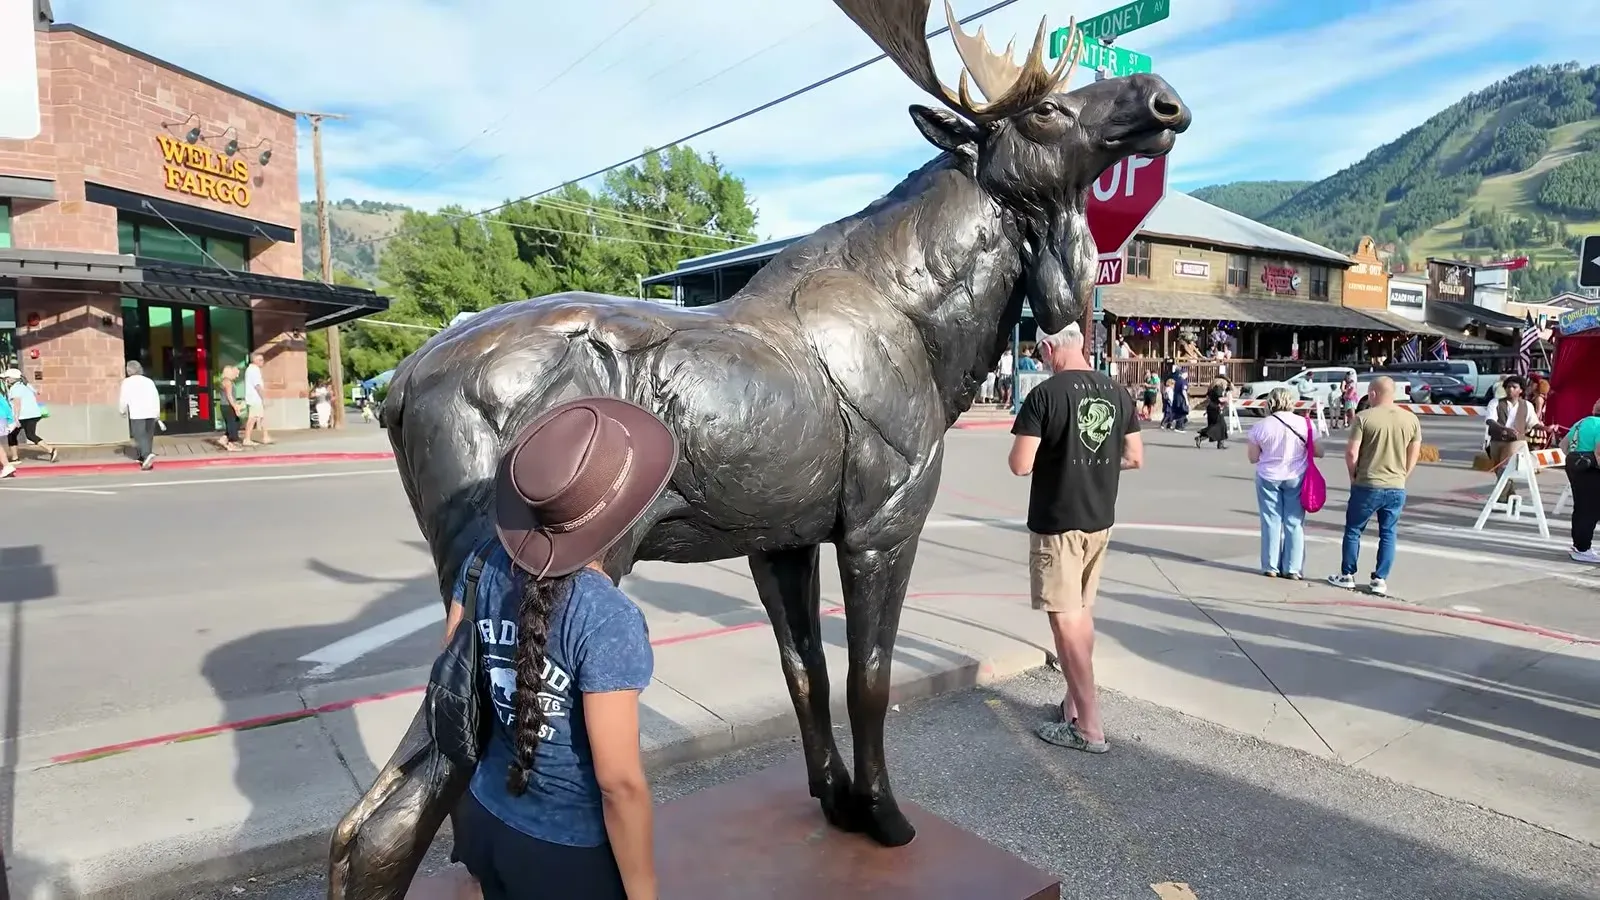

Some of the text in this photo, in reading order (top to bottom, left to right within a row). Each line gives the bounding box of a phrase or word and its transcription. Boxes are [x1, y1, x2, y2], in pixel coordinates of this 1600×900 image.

[1082, 1, 1165, 39] ELONEY AV
[1128, 53, 1139, 66] ST
[157, 135, 249, 184] WELLS
[1092, 155, 1154, 201] OP
[164, 165, 251, 208] FARGO
